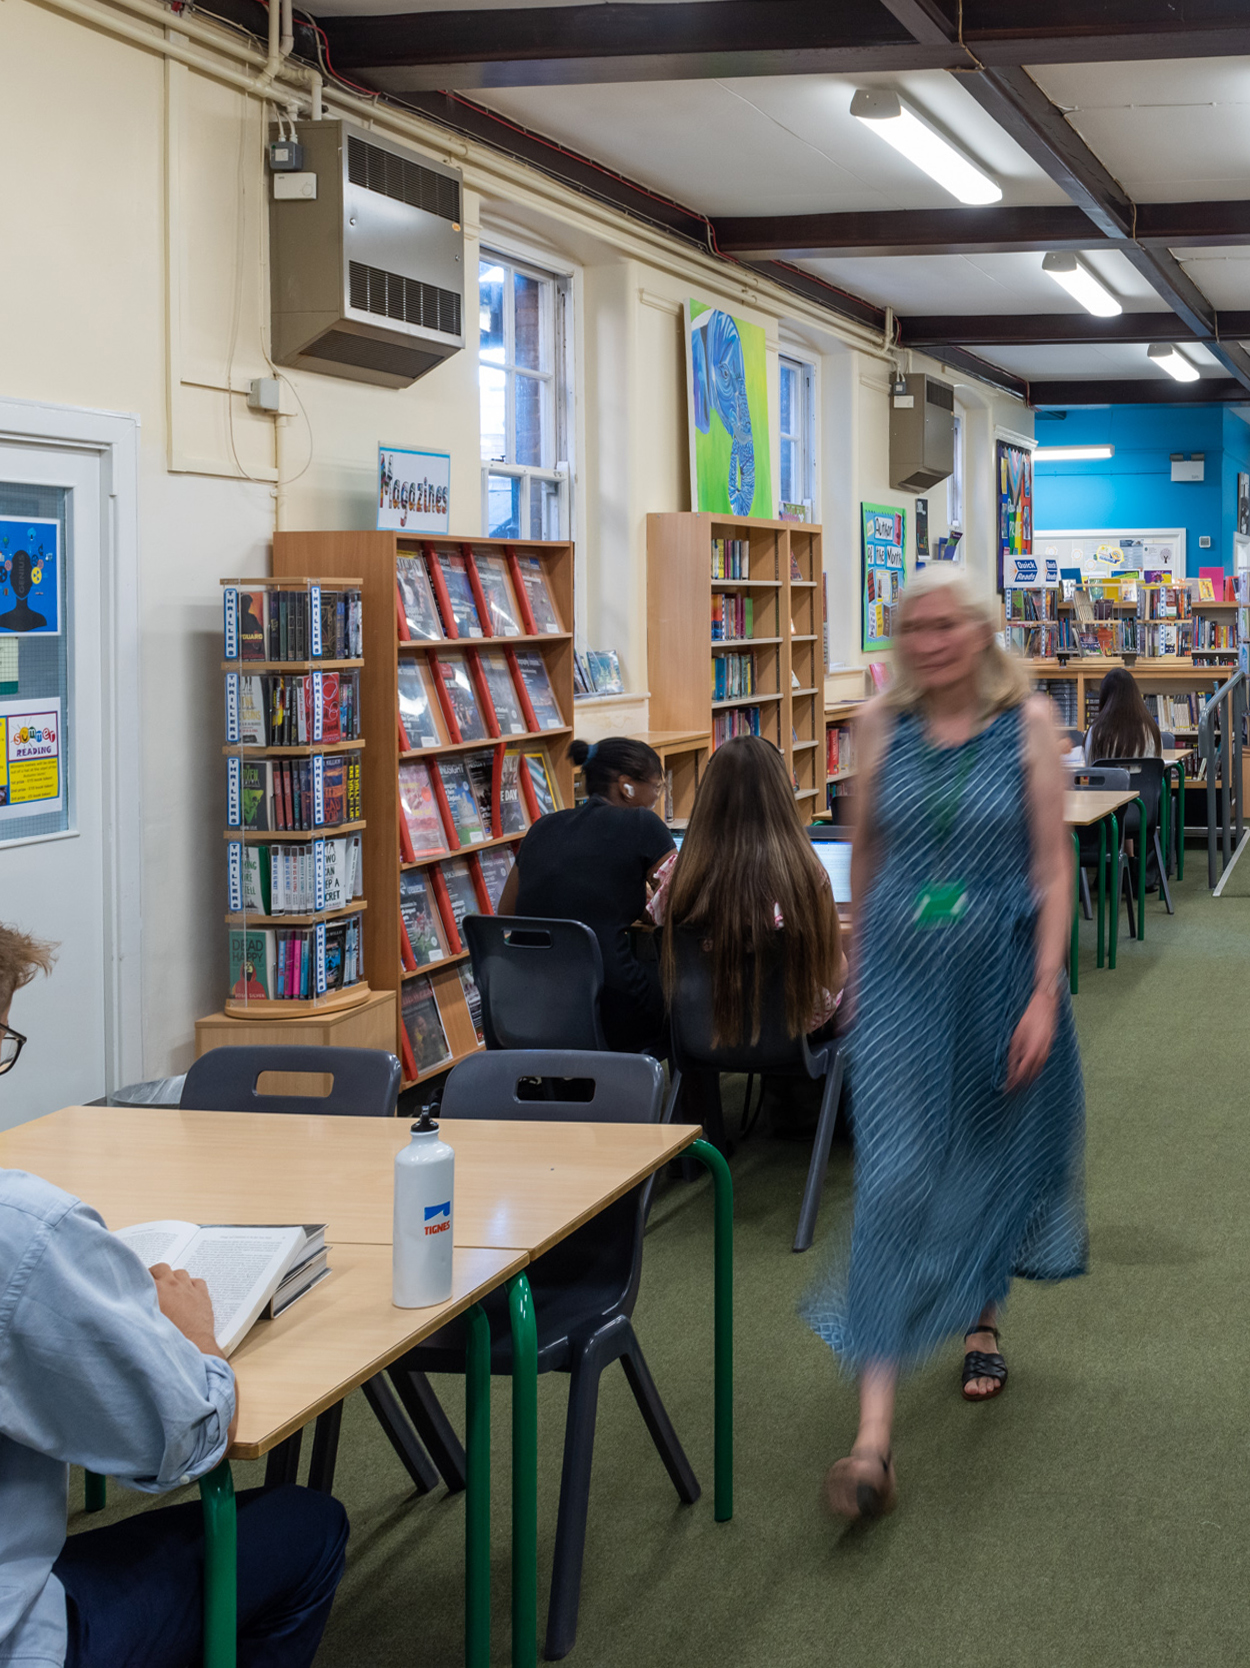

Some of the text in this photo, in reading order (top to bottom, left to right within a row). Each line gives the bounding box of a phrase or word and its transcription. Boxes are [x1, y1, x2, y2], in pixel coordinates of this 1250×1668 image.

[380, 453, 448, 527] Magazines
[875, 518, 893, 538] Author
[887, 548, 902, 567] Month
[1017, 561, 1036, 569] Quick
[1016, 572, 1036, 580] Reads
[227, 591, 235, 656] THRILLERS
[17, 746, 51, 757] READING
[505, 789, 517, 801] DAY
[231, 844, 239, 908] THRILLERS
[334, 878, 340, 888] A
[325, 890, 340, 901] CRET
[232, 939, 263, 951] DEAD
[232, 953, 263, 962] HAPPY
[424, 1220, 450, 1236] TIGNES
